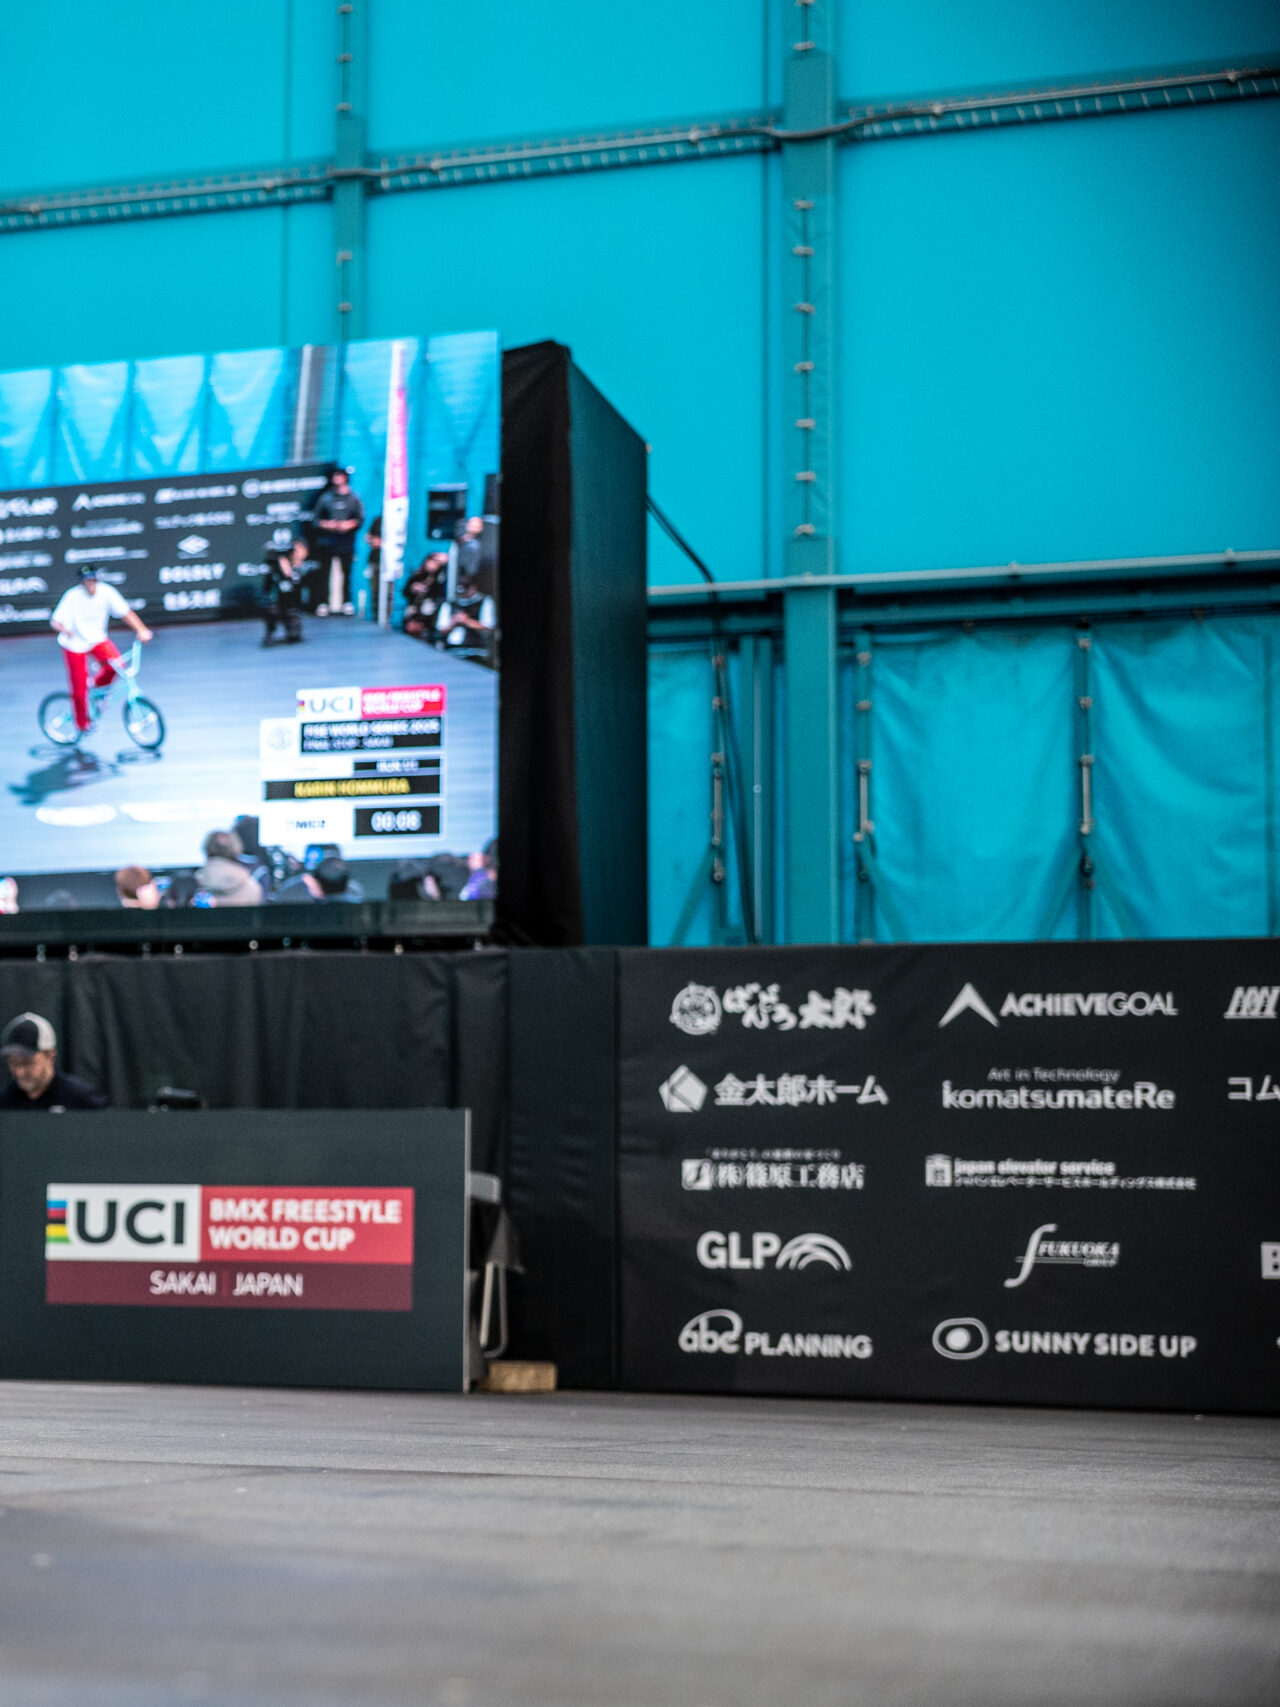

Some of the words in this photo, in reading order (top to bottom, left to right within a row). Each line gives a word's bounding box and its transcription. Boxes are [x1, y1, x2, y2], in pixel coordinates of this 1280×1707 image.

[309, 696, 354, 713] UCI
[999, 991, 1178, 1017] ACHIEVEGOAL
[714, 1072, 889, 1107] 金太郎ホーム
[987, 1067, 1011, 1082] Art
[1014, 1068, 1031, 1082] in
[1032, 1067, 1121, 1085] Technology
[942, 1079, 1176, 1110] komatsumateRe
[953, 1157, 996, 1177] japan
[997, 1157, 1059, 1176] elevator
[1059, 1157, 1117, 1177] service
[75, 1200, 186, 1245] UCI
[209, 1197, 269, 1223] BMX
[271, 1198, 402, 1225] FREESTYLE
[208, 1225, 299, 1251] WORLD
[302, 1226, 356, 1252] CUP
[696, 1230, 782, 1270] GLP
[149, 1269, 218, 1296] SAKAI
[232, 1272, 304, 1298] JAPAN
[745, 1332, 873, 1359] PLANNING
[994, 1329, 1092, 1354] SUNNY
[1093, 1331, 1155, 1356] SIDE
[1158, 1334, 1198, 1358] UP
